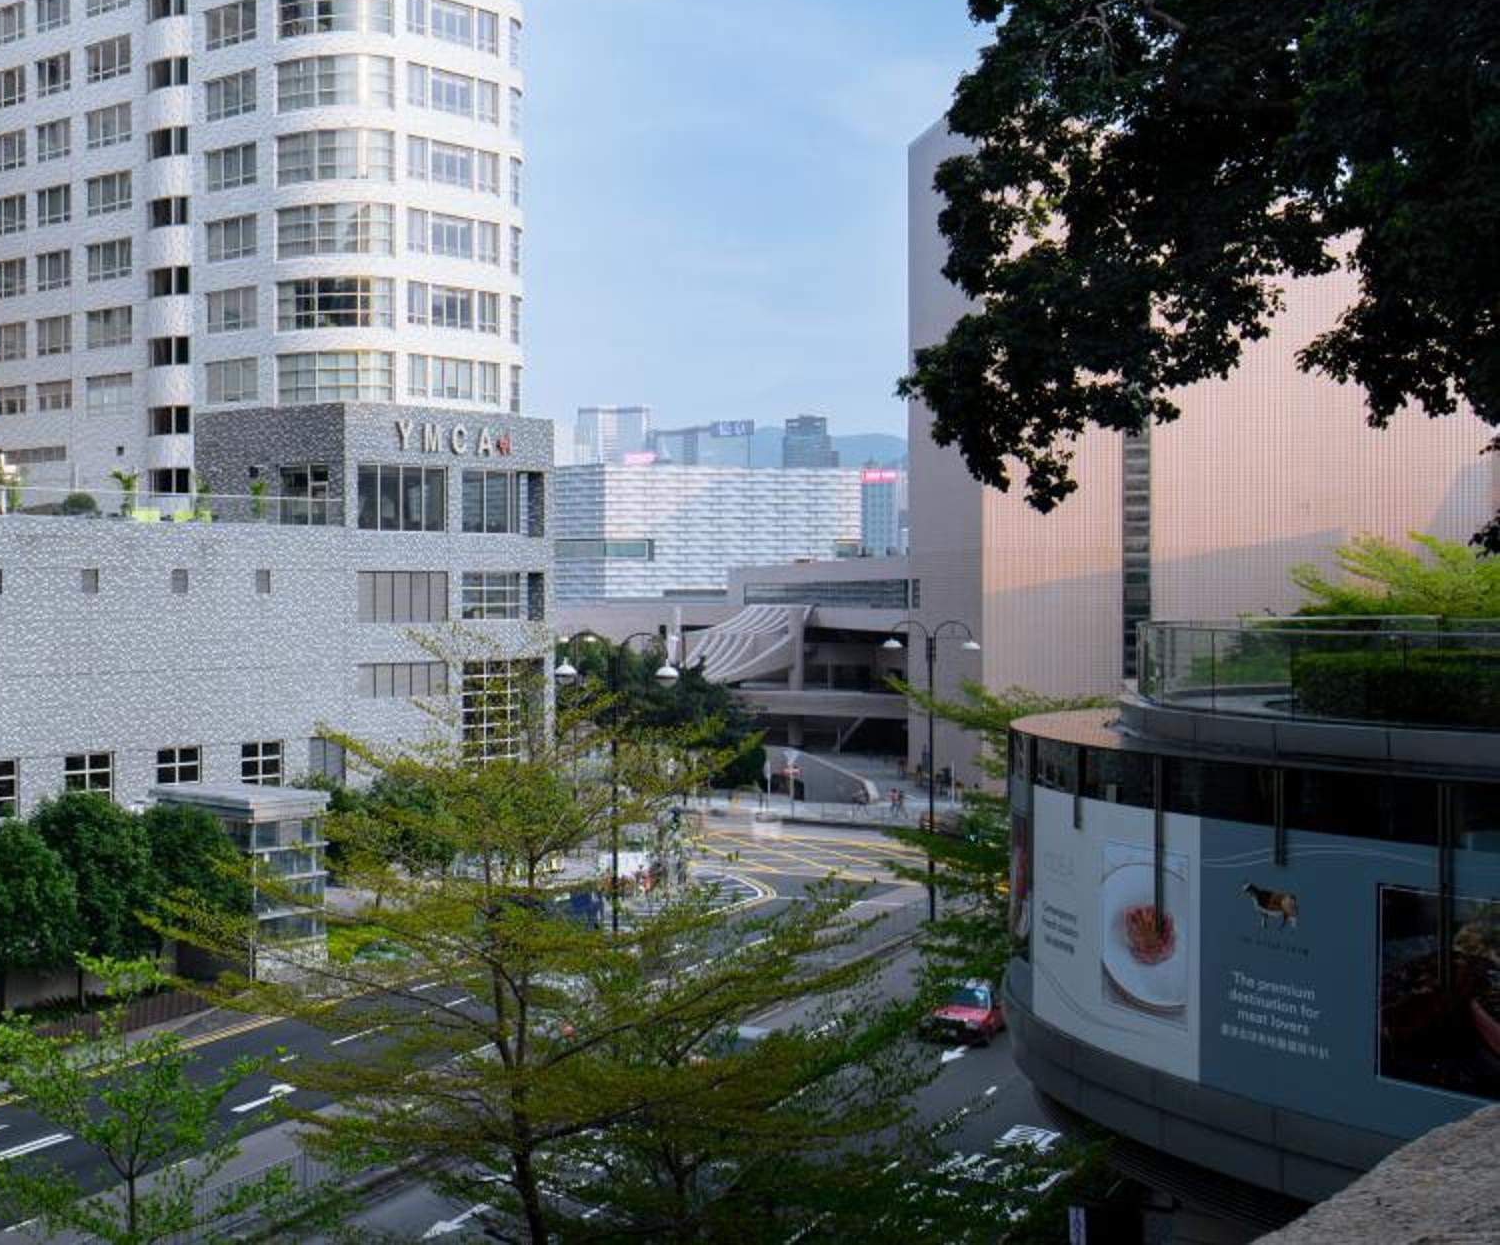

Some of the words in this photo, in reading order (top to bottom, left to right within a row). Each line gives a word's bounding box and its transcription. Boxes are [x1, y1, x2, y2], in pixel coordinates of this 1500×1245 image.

[395, 419, 493, 457] YMCA
[1231, 970, 1254, 988] The
[1256, 980, 1315, 1002] premium
[1228, 988, 1297, 1013] destination
[1300, 1004, 1321, 1019] for
[1237, 1010, 1268, 1026] meat
[1271, 1014, 1311, 1036] lovers
